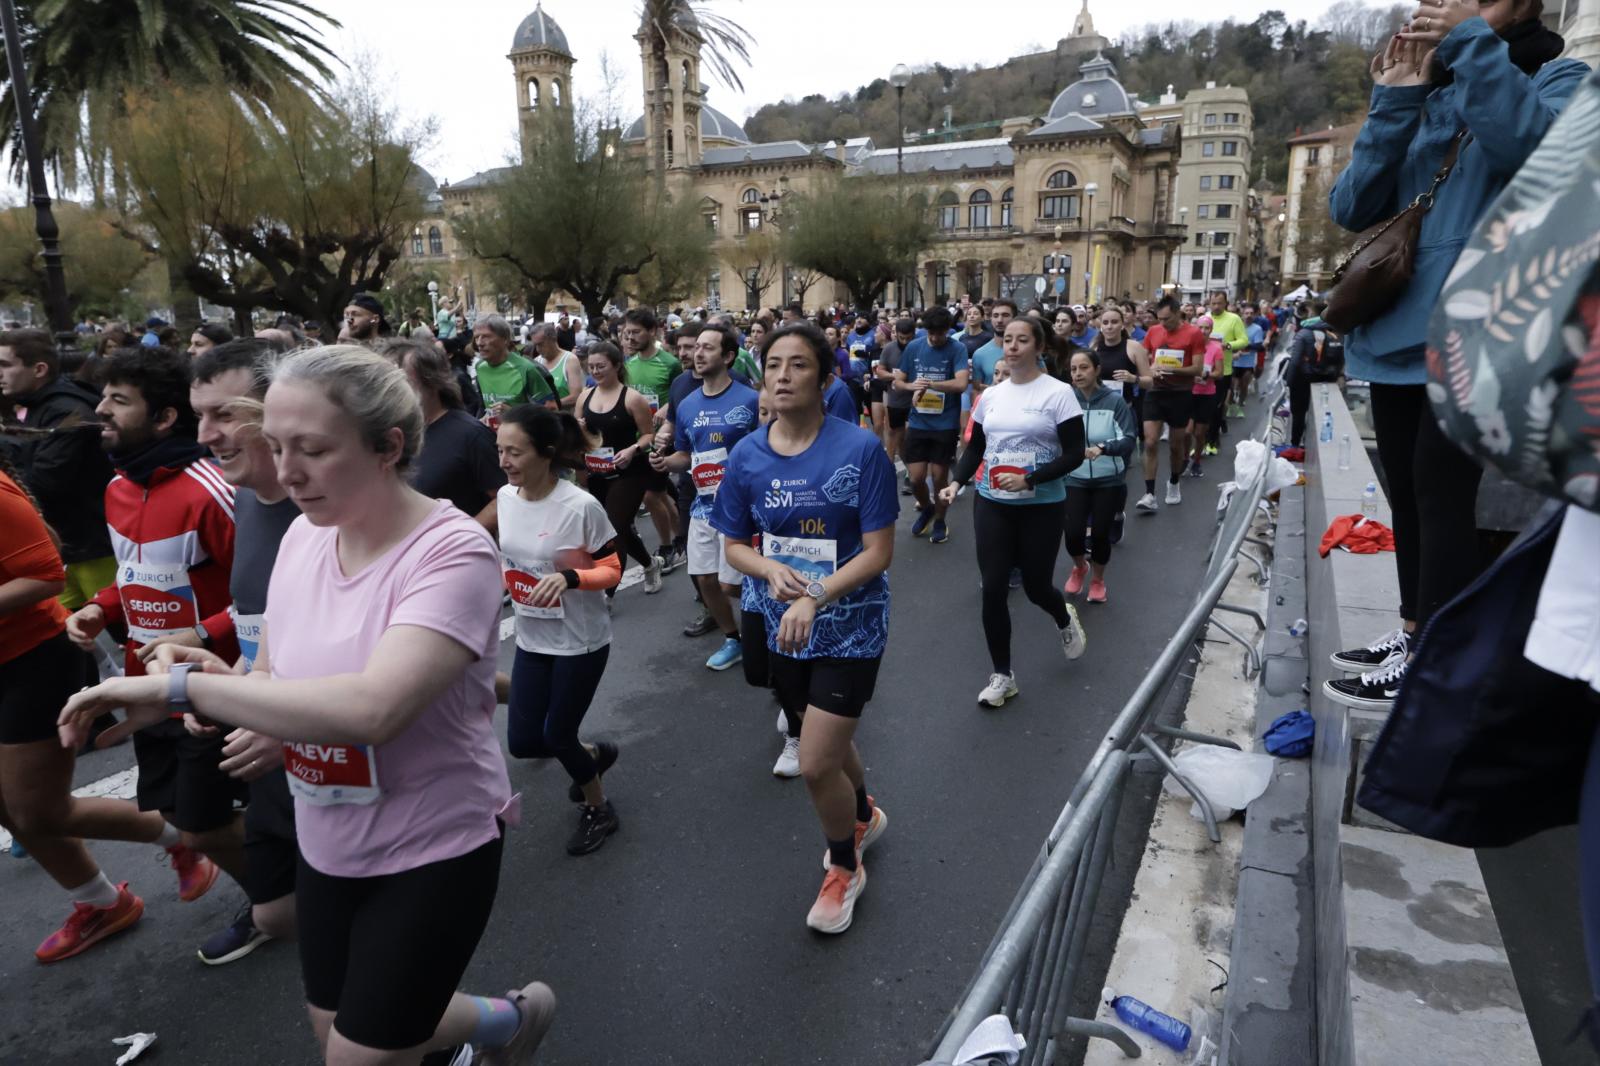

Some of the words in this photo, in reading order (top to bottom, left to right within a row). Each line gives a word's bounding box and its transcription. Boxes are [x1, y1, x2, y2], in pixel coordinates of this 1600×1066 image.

[709, 432, 723, 443] 10k
[783, 479, 807, 487] ZURICH
[764, 490, 793, 509] SSM
[798, 517, 826, 535] 10k
[785, 544, 821, 556] ZURICH
[136, 572, 174, 583] ZURICH
[800, 570, 826, 582] REA
[514, 581, 535, 593] ITXA
[129, 599, 181, 613] SERGIO
[136, 616, 166, 628] 10447
[238, 624, 262, 637] ZUR
